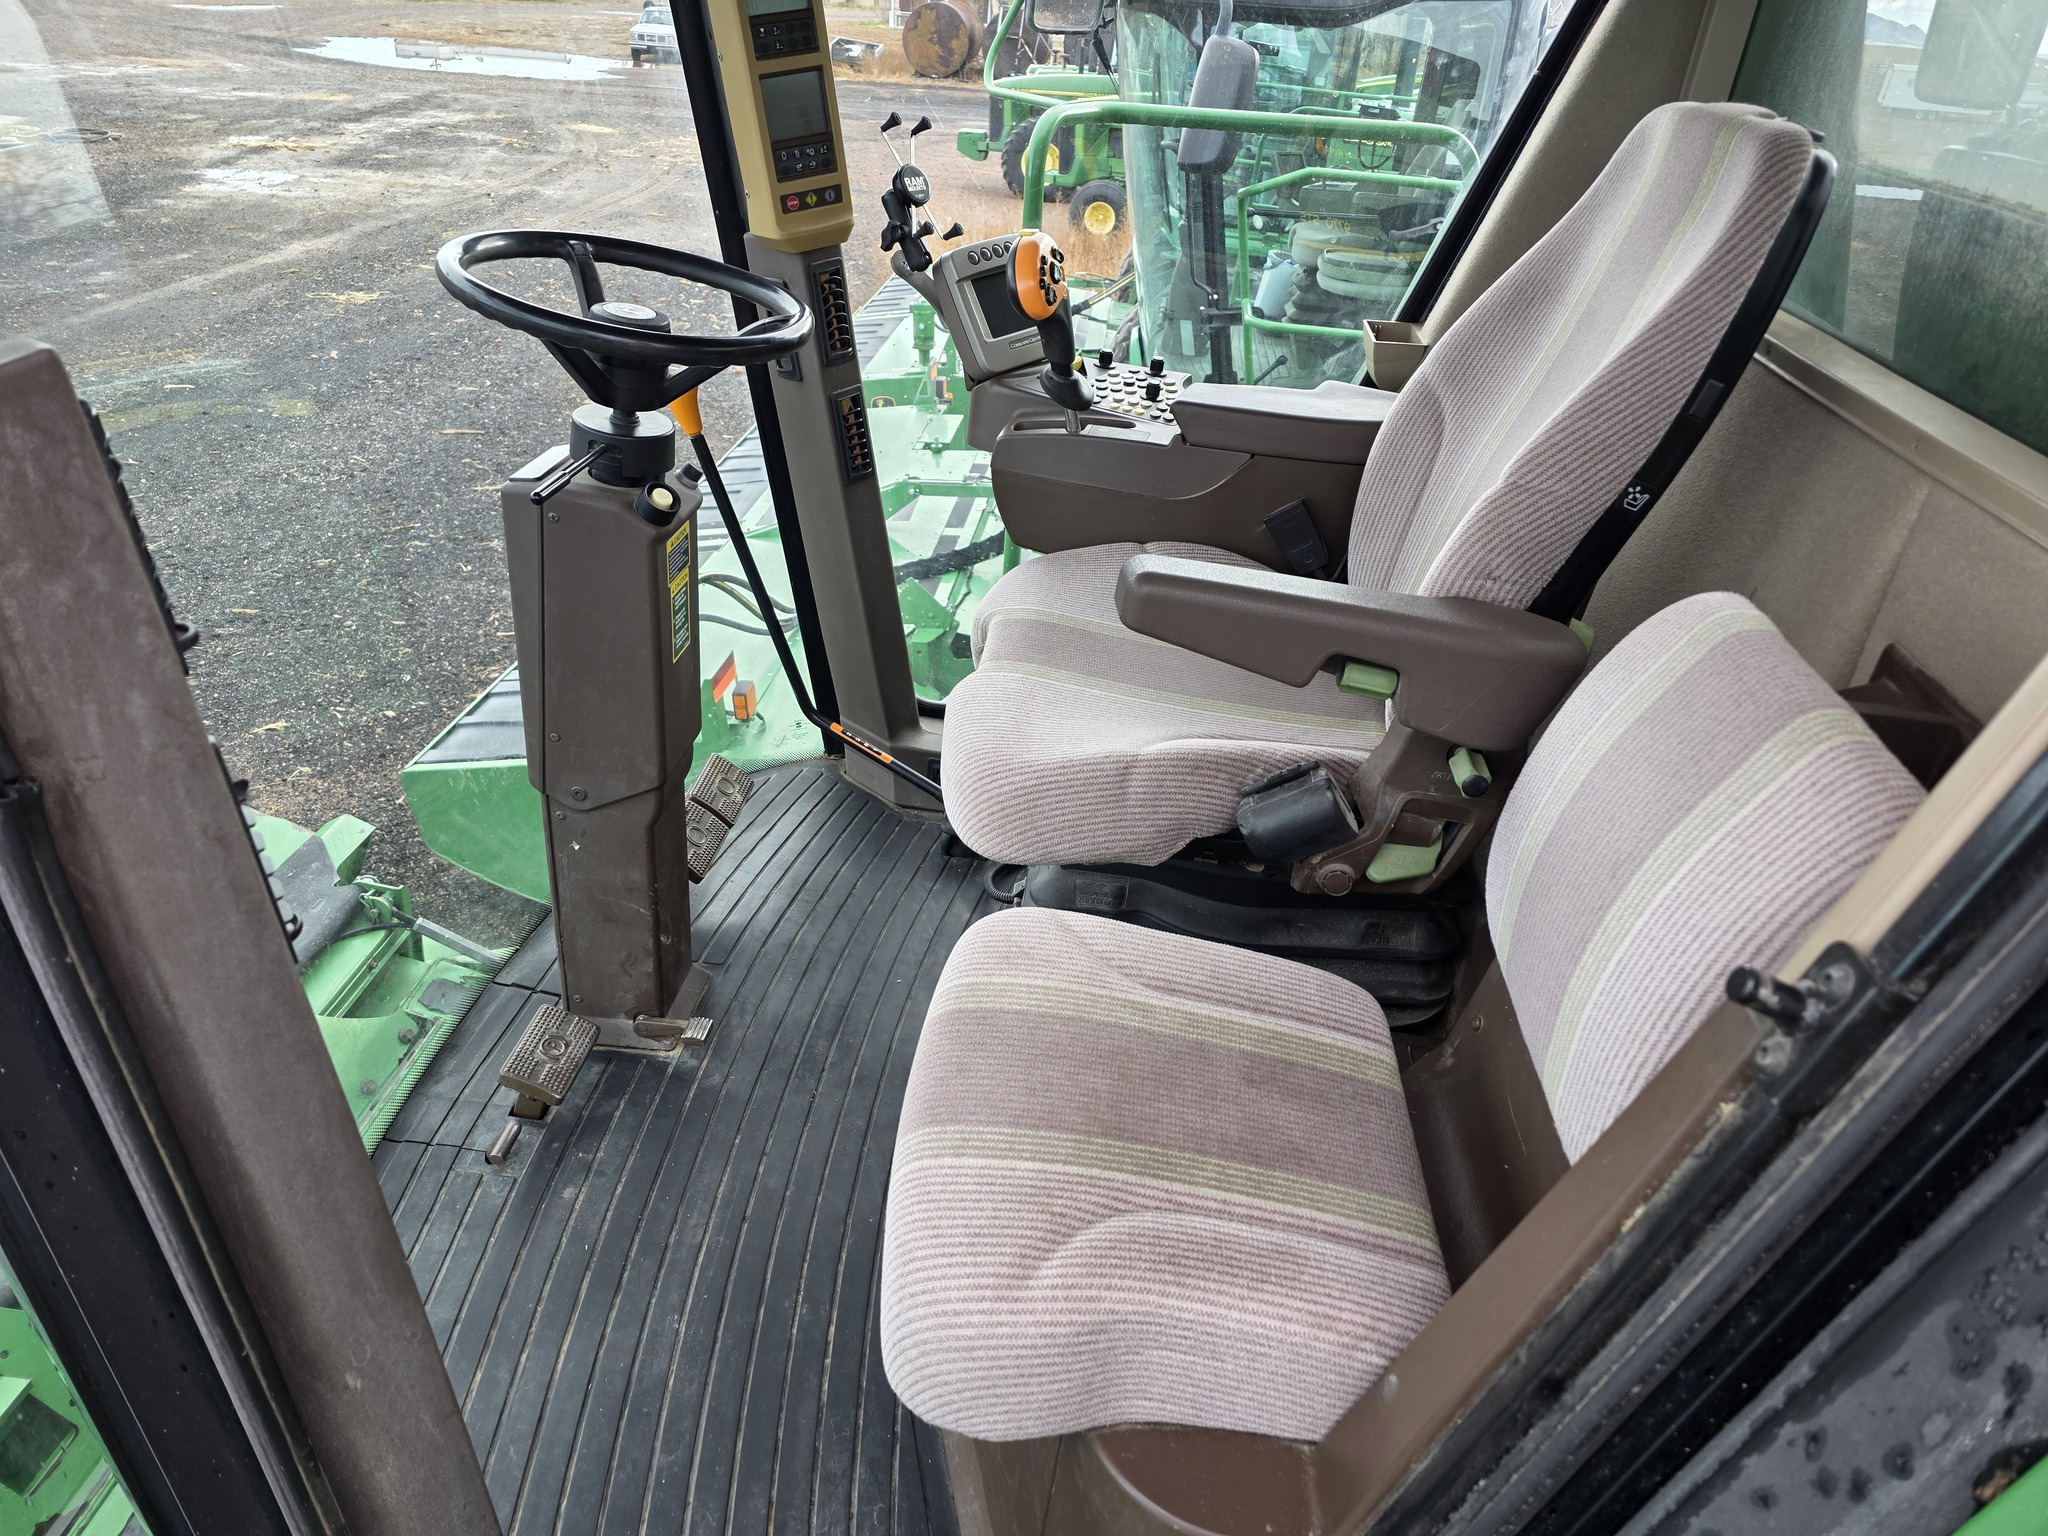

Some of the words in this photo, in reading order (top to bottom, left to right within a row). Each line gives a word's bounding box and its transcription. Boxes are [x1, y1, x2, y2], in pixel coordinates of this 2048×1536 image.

[904, 177, 925, 188] RAM
[674, 527, 687, 543] CAUTION
[675, 573, 688, 589] CAUTION
